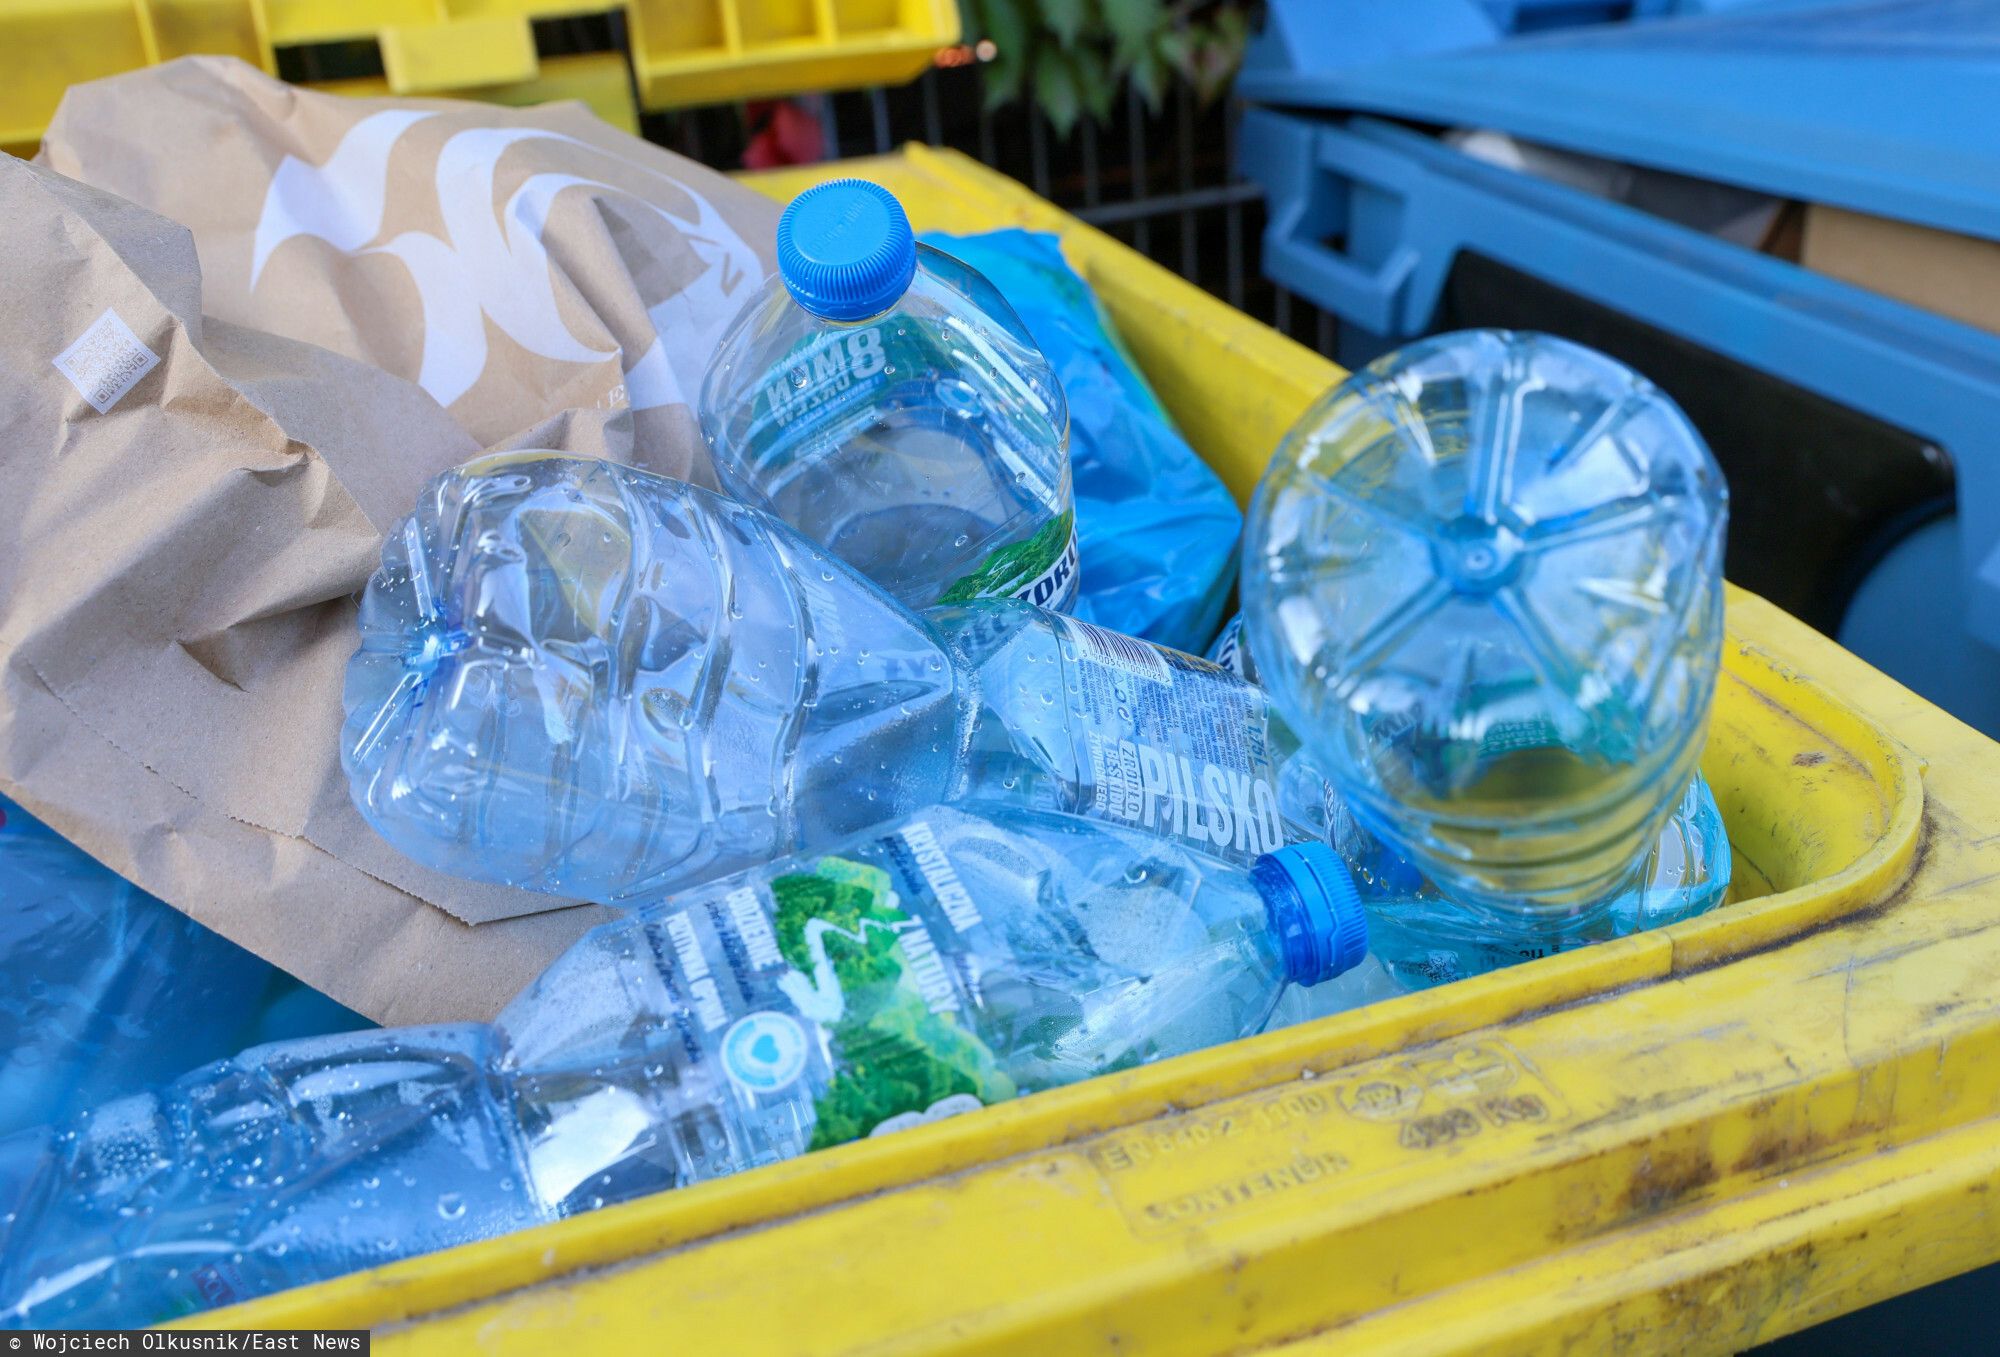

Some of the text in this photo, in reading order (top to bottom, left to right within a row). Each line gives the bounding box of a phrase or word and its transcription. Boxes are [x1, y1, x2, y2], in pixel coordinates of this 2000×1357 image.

[1106, 750, 1126, 817] BESKIDU
[1139, 744, 1284, 852] PILSKO
[900, 821, 983, 932] KRYSTALICZNA
[899, 927, 961, 1015] NATURY
